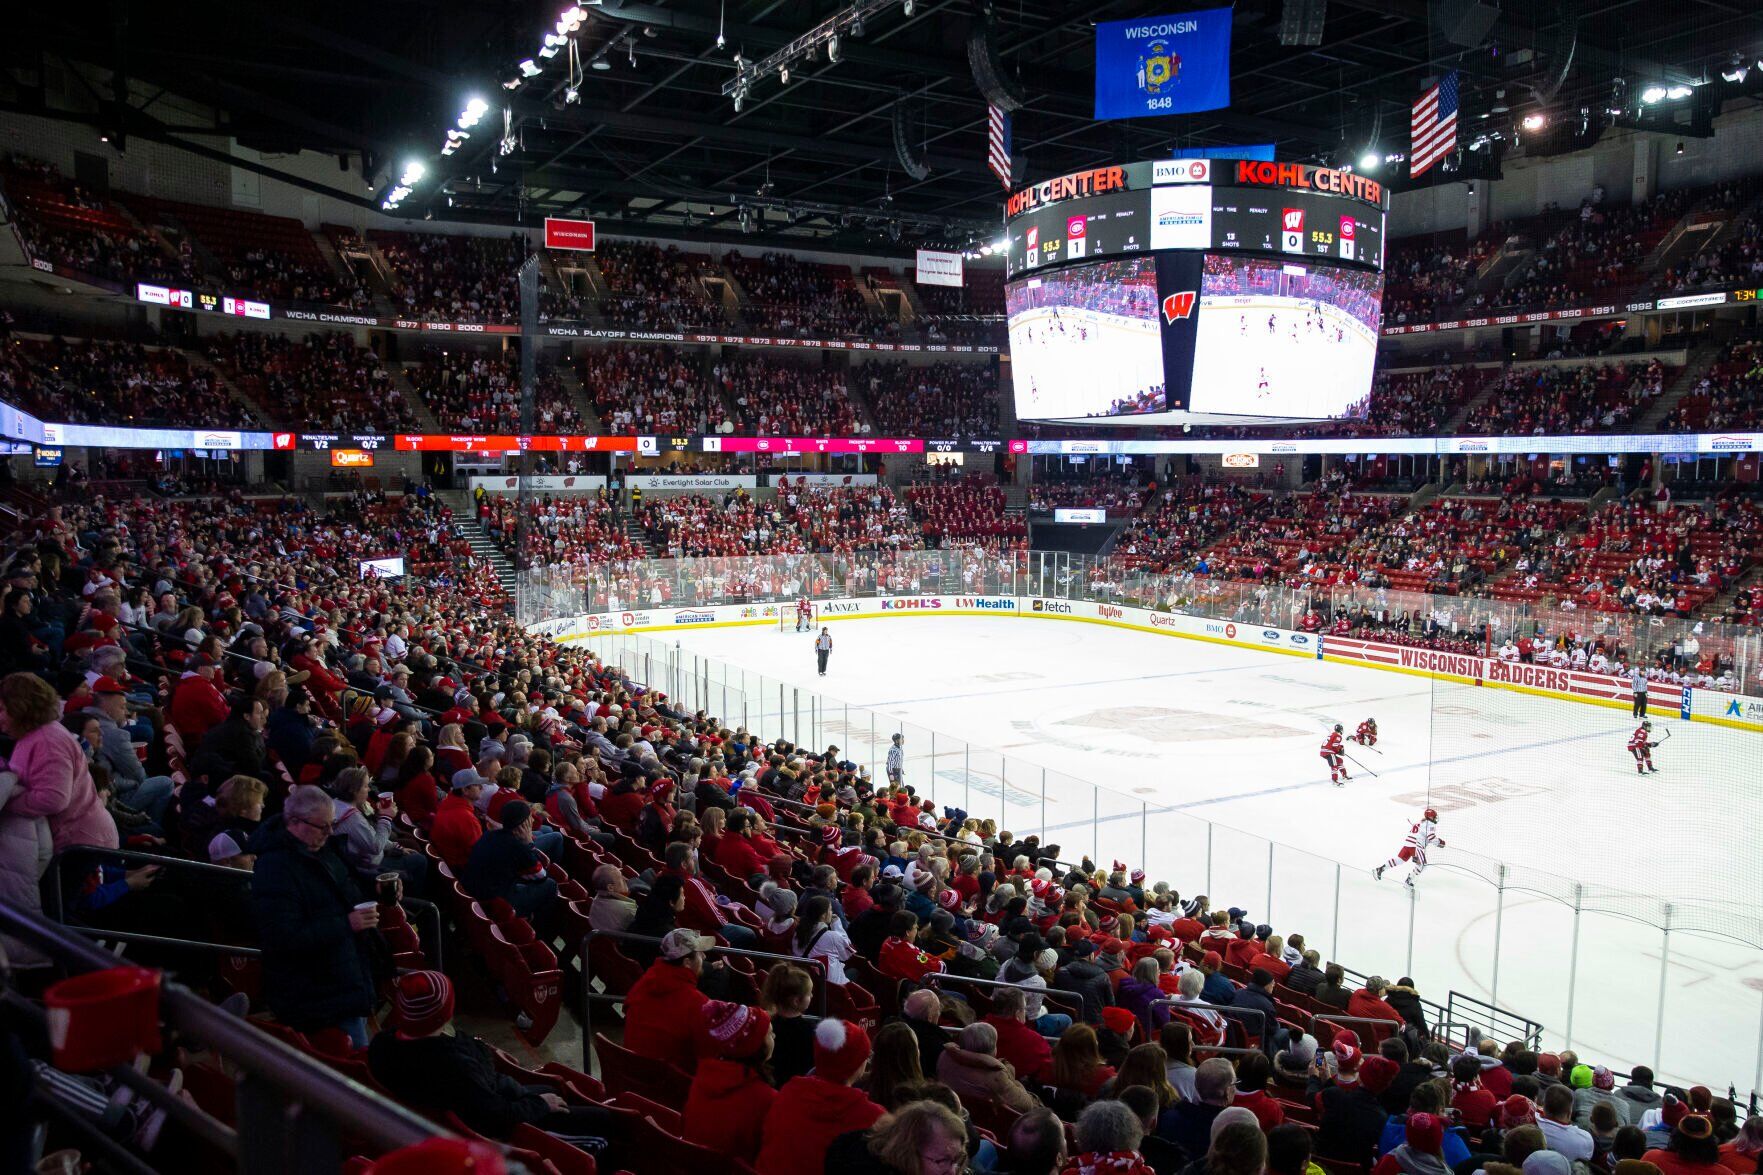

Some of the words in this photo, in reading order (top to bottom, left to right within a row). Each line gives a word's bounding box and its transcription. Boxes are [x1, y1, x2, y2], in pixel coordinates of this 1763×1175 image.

[1125, 20, 1198, 39] WISCONSIN
[1147, 96, 1172, 110] 1848
[1156, 166, 1185, 177] BMO
[1238, 160, 1310, 187] KOHL
[1314, 167, 1382, 204] CENTER
[1008, 186, 1036, 217] KOHL
[1040, 166, 1124, 200] CENTER
[1289, 235, 1297, 247] 0
[1312, 231, 1332, 244] 55.3
[1043, 239, 1060, 252] 55.3
[1074, 242, 1079, 253] 1
[1317, 245, 1328, 253] 1ST
[1345, 243, 1349, 255] 1
[184, 295, 189, 303] 0
[200, 294, 217, 305] 55.3
[1734, 290, 1756, 301] 7:34
[1162, 290, 1196, 325] W
[1466, 319, 1488, 327] 1983
[1526, 312, 1549, 321] 1989
[1557, 309, 1581, 318] 1990
[1591, 306, 1615, 315] 1991
[1625, 302, 1653, 312] 1992
[286, 311, 317, 320] WCHA
[320, 313, 377, 326] CHAMPIONS
[396, 321, 418, 329] 1977
[427, 322, 451, 331] 1990
[458, 324, 484, 332] 2000
[548, 328, 578, 336] WCHA
[584, 329, 626, 338] PLAYOFF
[630, 332, 684, 341] CHAMPIONS
[696, 334, 717, 342] 1970
[723, 335, 744, 344] 1972
[750, 337, 770, 345] 1973
[777, 338, 795, 346] 1977
[314, 441, 328, 449] 1/2
[362, 441, 378, 449] 0/2
[466, 442, 473, 450] 7
[643, 440, 650, 448] 0
[336, 452, 368, 464] Quartz
[823, 602, 861, 613] ANNEX
[882, 598, 941, 609] KOHL'S
[956, 598, 1014, 609] UWHealth
[1044, 600, 1071, 613] fetch
[1150, 613, 1176, 627] Quartz
[1206, 623, 1224, 633] BMO
[1400, 648, 1484, 678] WISCONSIN
[1489, 661, 1569, 691] BADGERS
[1682, 688, 1690, 713] CCM
